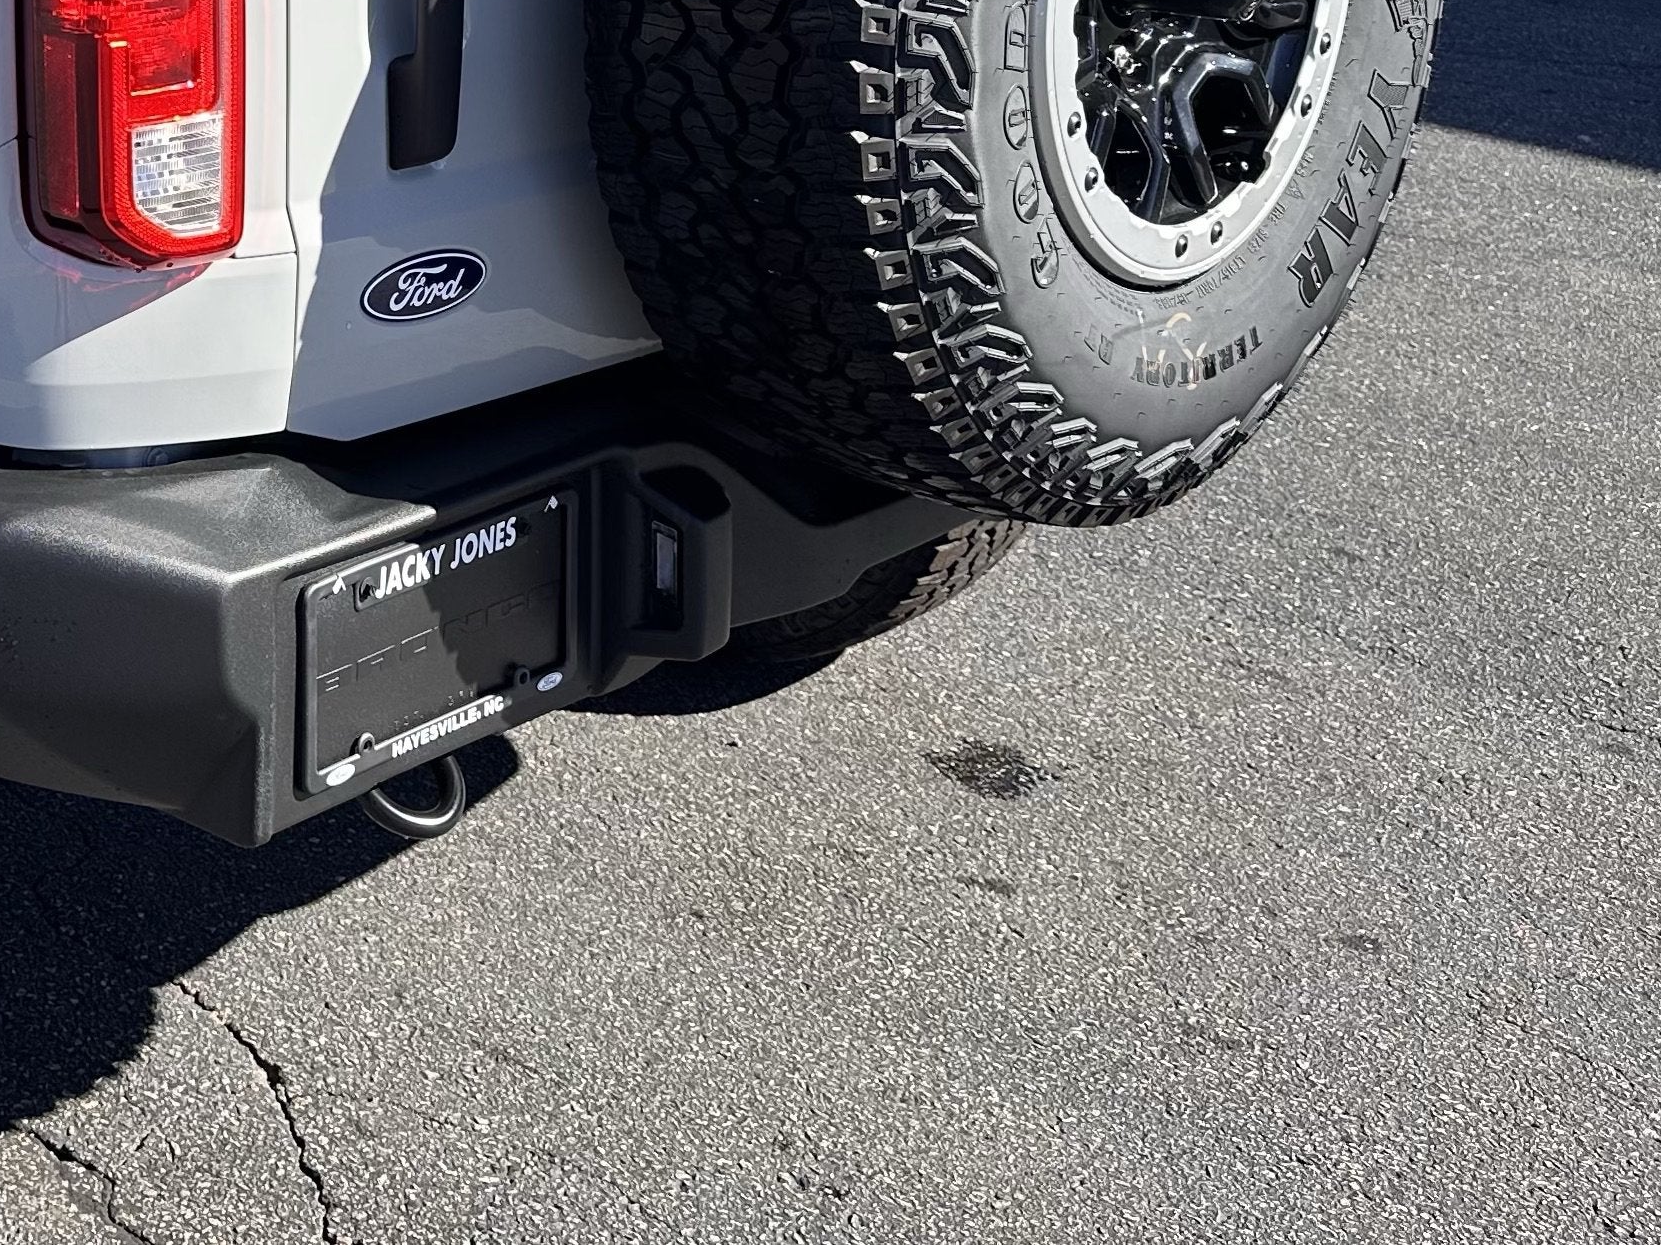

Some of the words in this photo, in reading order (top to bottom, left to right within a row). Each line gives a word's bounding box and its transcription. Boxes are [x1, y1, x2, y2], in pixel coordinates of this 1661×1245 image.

[374, 543, 445, 599] JACKY
[449, 516, 517, 570] JONES
[483, 695, 505, 718] NC
